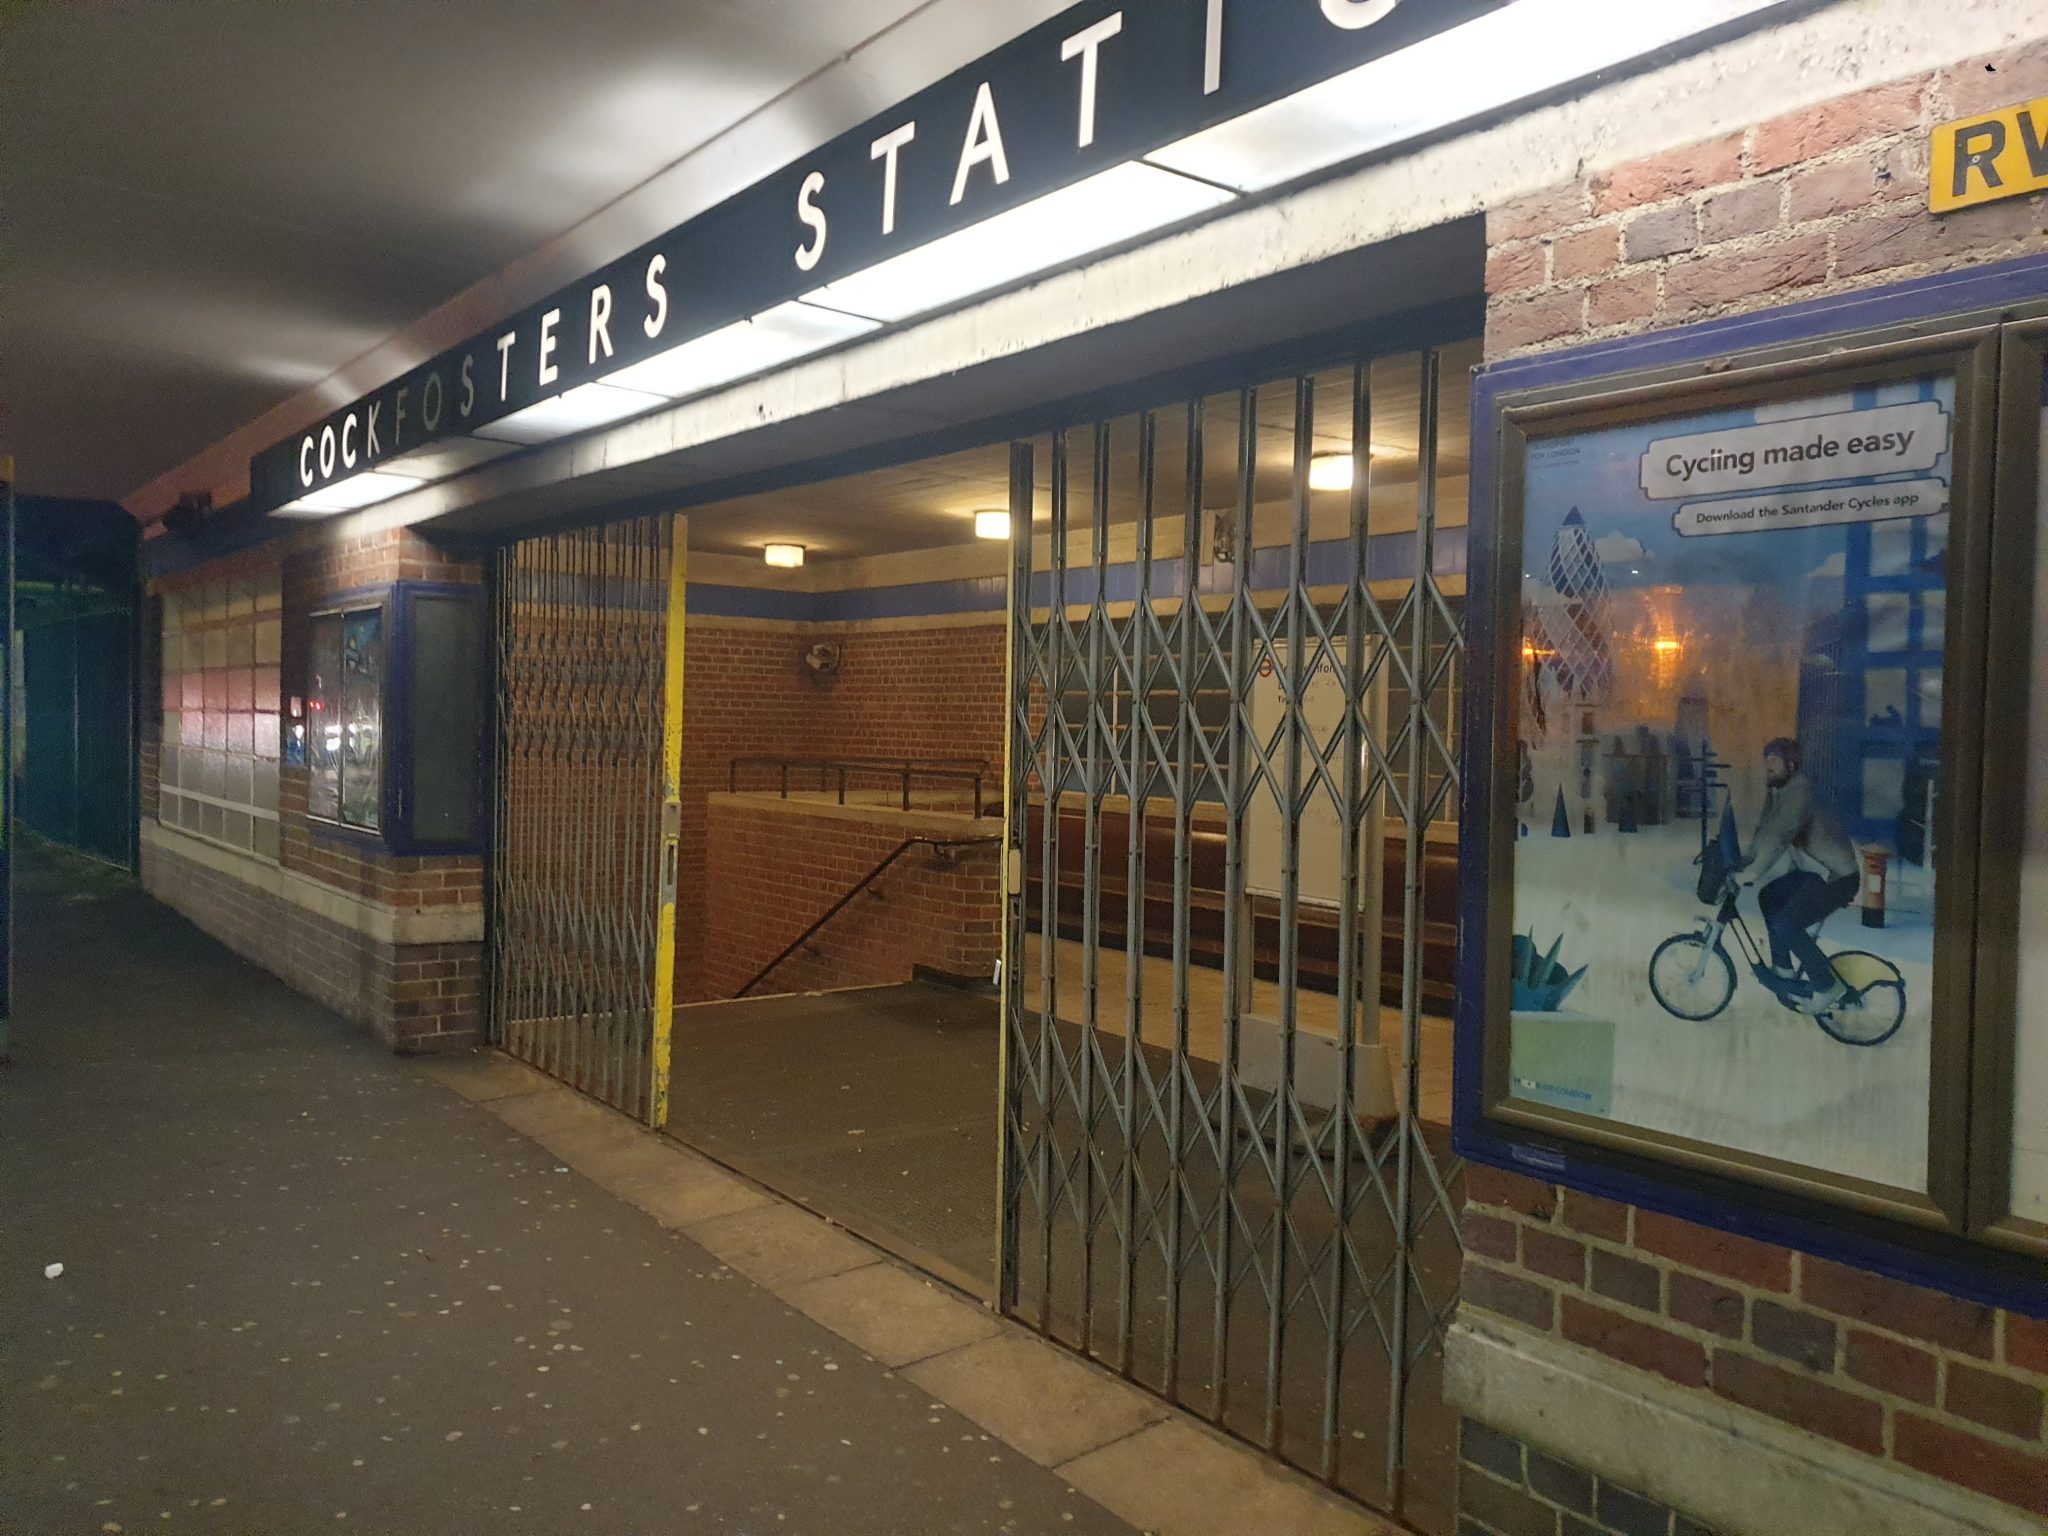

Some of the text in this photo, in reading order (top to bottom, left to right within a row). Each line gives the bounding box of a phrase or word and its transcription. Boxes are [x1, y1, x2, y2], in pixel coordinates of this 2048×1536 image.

[299, 0, 1400, 487] COCKFOSTERS STATI
[1764, 434, 1840, 465] made
[1847, 430, 1915, 456] easy
[1696, 494, 1919, 524] Download the Santander Cycles app
